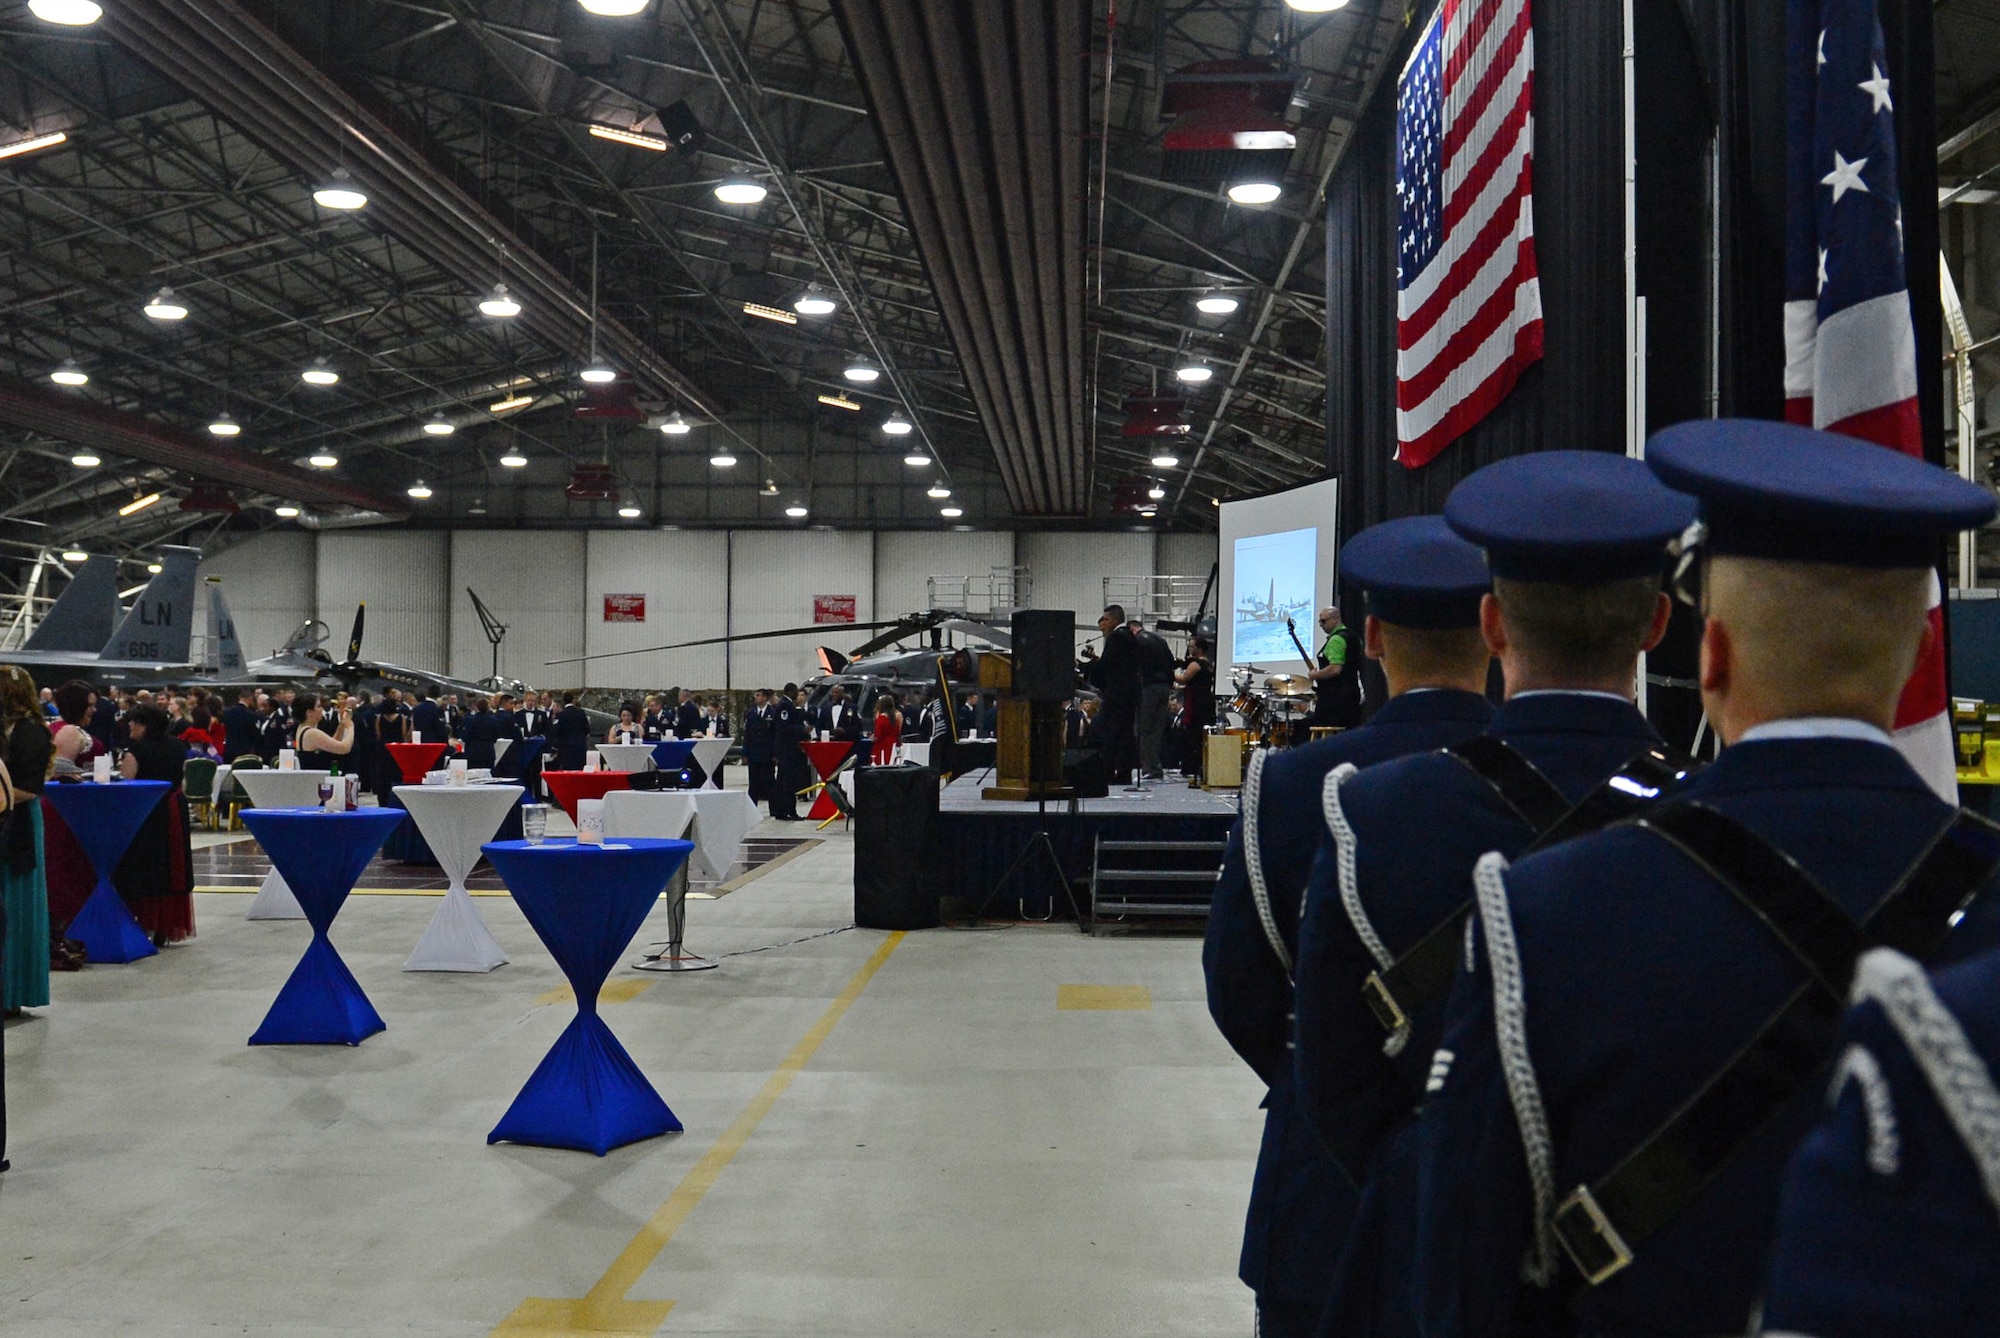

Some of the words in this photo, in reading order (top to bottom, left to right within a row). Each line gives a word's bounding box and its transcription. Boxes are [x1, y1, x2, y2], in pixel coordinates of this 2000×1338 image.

[141, 600, 171, 626] LN
[219, 619, 234, 641] LN
[129, 642, 158, 657] 605
